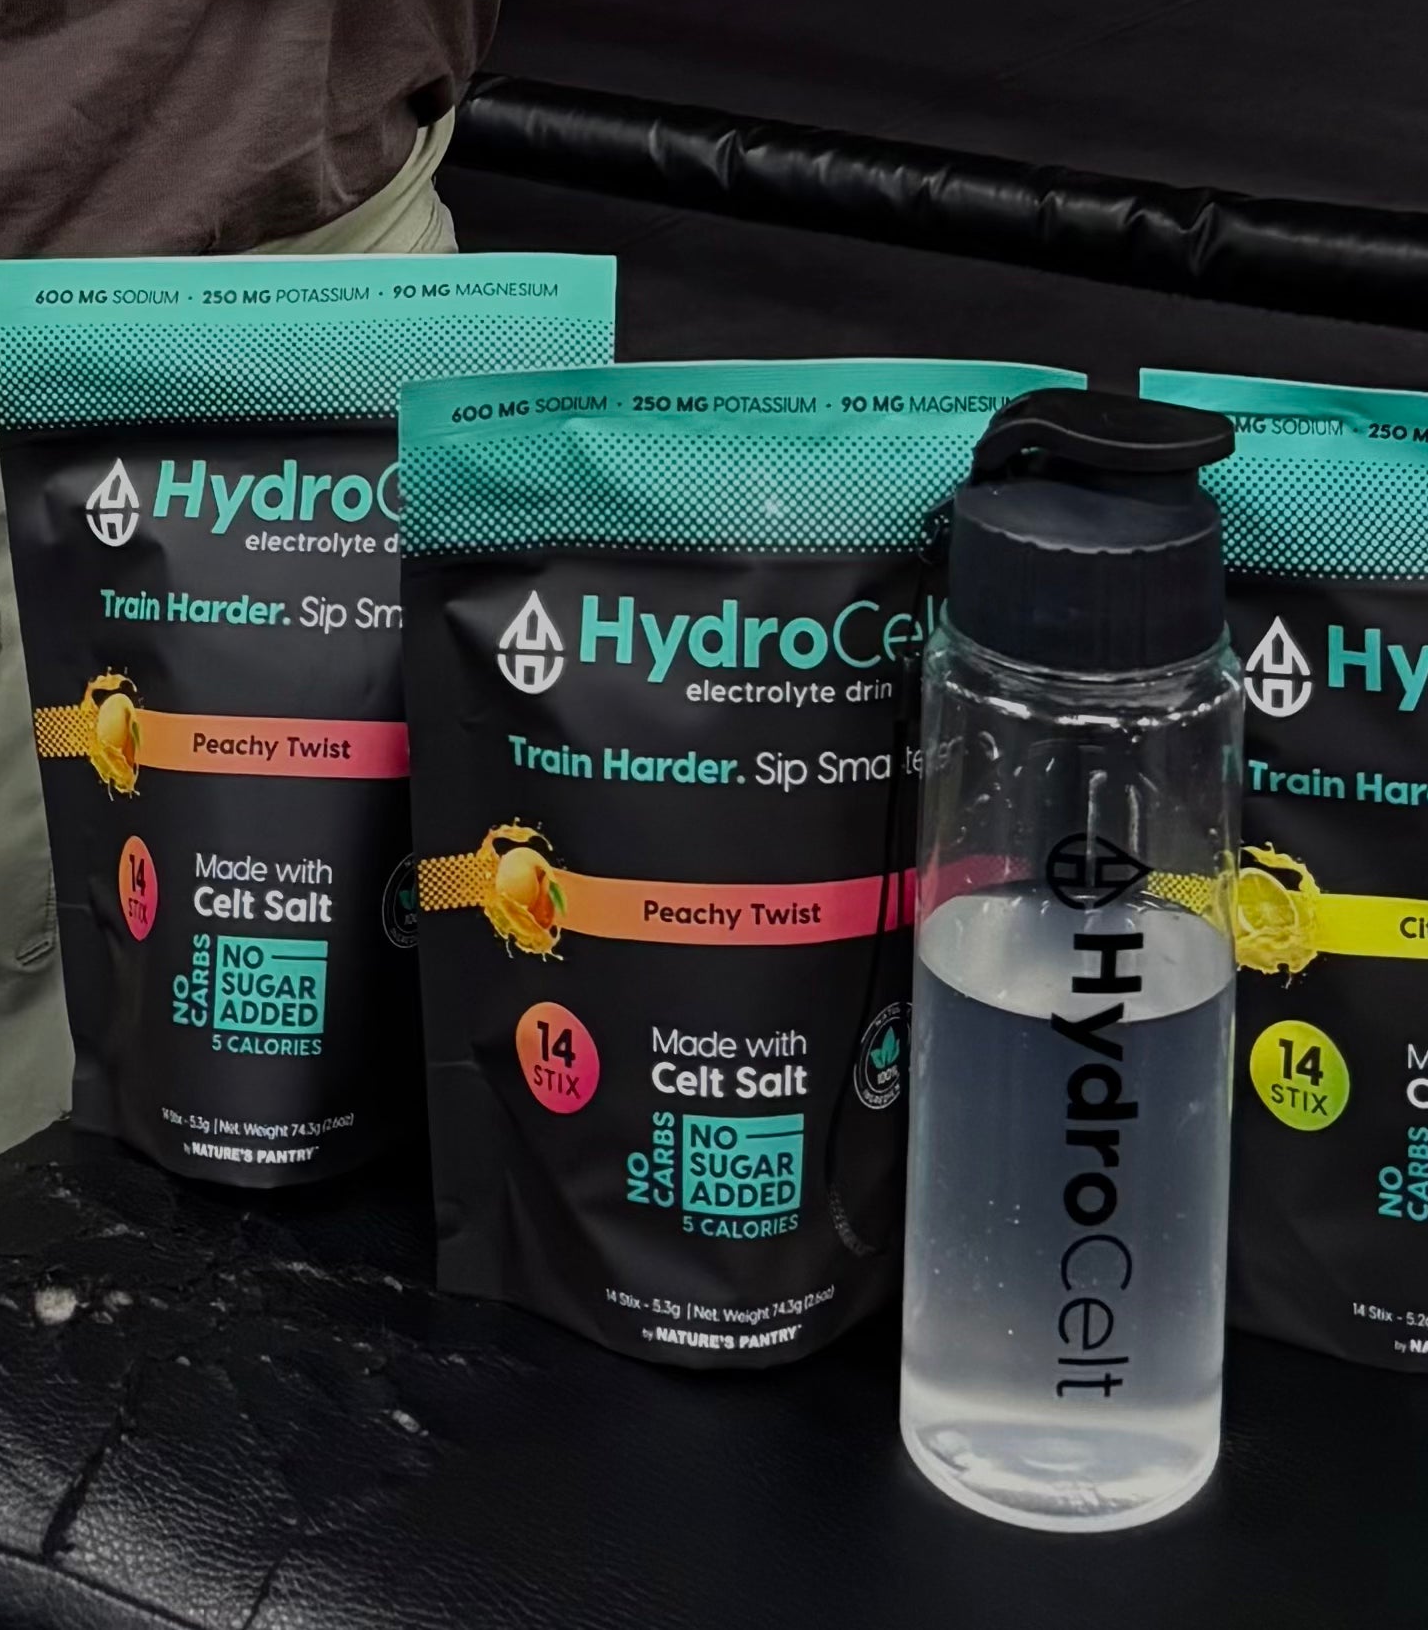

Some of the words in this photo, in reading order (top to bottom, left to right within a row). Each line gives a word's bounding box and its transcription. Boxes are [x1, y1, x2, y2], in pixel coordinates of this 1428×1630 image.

[36, 290, 73, 304] 600
[79, 290, 107, 303] MG
[113, 290, 179, 304] SODIUM
[203, 290, 237, 304] 250
[243, 290, 271, 303] MG
[276, 287, 369, 303] POTASSIUM
[394, 285, 416, 298] 90
[422, 284, 450, 297] MG
[456, 283, 558, 296] MAGNESIUM
[452, 404, 493, 423] 600
[499, 400, 529, 417] MG
[536, 396, 607, 413] SODIUM
[633, 396, 671, 411] 250
[677, 397, 708, 412] MG
[713, 396, 816, 413] POTASSIUM
[842, 396, 867, 412] 90
[873, 396, 904, 412] MG
[1271, 415, 1344, 436] SODIUM
[1368, 423, 1407, 440] 250
[245, 531, 376, 556] electrolyte
[101, 590, 160, 620] Train
[166, 593, 290, 625] Harder.
[300, 596, 347, 634] Sip
[686, 680, 835, 707] electrolyte
[846, 680, 892, 702] drin
[193, 733, 279, 761] Peachy
[287, 737, 351, 759] Twist
[509, 735, 592, 778] Train
[604, 750, 745, 783] Harder.
[756, 752, 807, 792] Sip
[1248, 760, 1344, 798] Train
[130, 854, 146, 896] 14
[196, 853, 267, 881] Made
[276, 859, 332, 884] with
[128, 898, 148, 924] STIX
[194, 886, 255, 919] Celt
[264, 891, 332, 922] Salt
[644, 900, 741, 930] Peachy
[751, 903, 821, 925] Twist
[223, 944, 263, 969] NO
[191, 934, 210, 1027] CARBS
[222, 972, 316, 999] SUGAR
[173, 975, 189, 1024] NO
[220, 1000, 318, 1027] ADDED
[212, 1034, 222, 1050] 5
[227, 1036, 321, 1055] CALORIES
[535, 1021, 575, 1069] 14
[653, 1027, 737, 1058] Made
[746, 1030, 806, 1057] with
[1277, 1039, 1323, 1087] 14
[532, 1065, 578, 1100] STIX
[652, 1062, 724, 1097] Celt
[736, 1065, 807, 1098] Salt
[1271, 1084, 1327, 1117] STIX
[244, 1123, 288, 1139] Weight
[691, 1124, 737, 1150] NO
[192, 1142, 253, 1163] NATURE'S
[653, 1112, 674, 1207] CARBS
[690, 1152, 794, 1179] SUGAR
[1052, 933, 1143, 1397] HydroCelt
[627, 1152, 649, 1203] NO
[1379, 1166, 1403, 1217] NO
[690, 1180, 795, 1207] ADDED
[683, 1216, 694, 1232] 5
[701, 1214, 797, 1238] CALORIES
[619, 1292, 641, 1309] Stix
[723, 1307, 770, 1325] Weight
[1353, 1303, 1365, 1316] 14
[1369, 1306, 1392, 1321] Stix
[656, 1326, 734, 1348] NATURE'S
